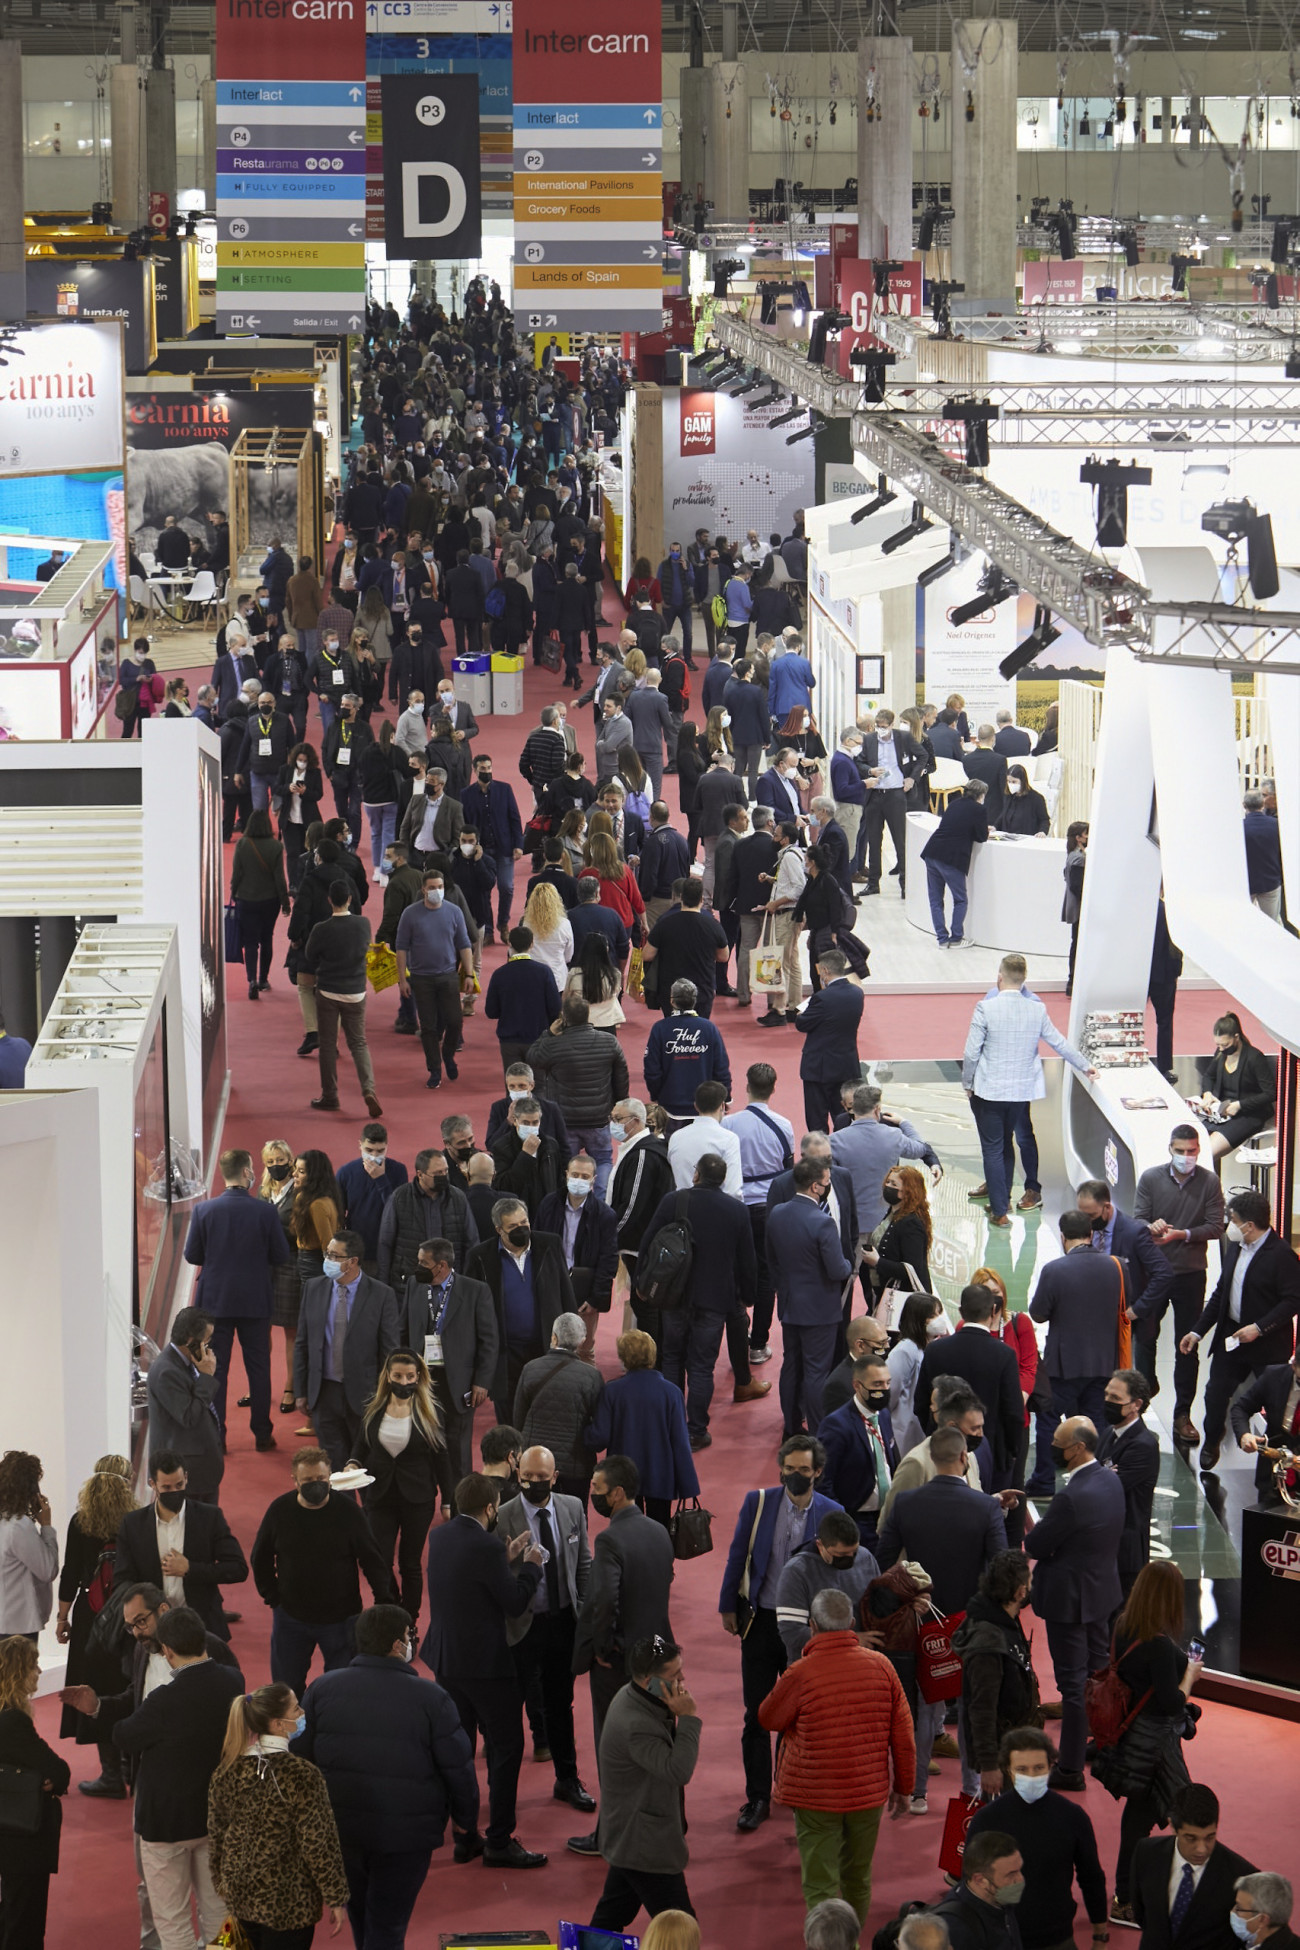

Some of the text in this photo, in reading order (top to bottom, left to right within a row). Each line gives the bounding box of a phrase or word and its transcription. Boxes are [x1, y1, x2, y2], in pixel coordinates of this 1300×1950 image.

[229, 0, 354, 20] Intercarn
[383, 3, 412, 16] CC3
[524, 28, 649, 54] Intercarn
[416, 38, 430, 59] 3
[230, 88, 283, 101] Interlact
[421, 104, 440, 117] P3
[527, 112, 580, 124] Interlact
[234, 132, 247, 142] P4
[233, 157, 299, 169] Restaurama
[527, 156, 541, 165] P2
[282, 183, 336, 192] EQUIPPED
[527, 180, 634, 190] International Pavilions
[401, 161, 467, 238] D
[528, 204, 601, 216] Grocery Foods
[232, 224, 246, 233] P6
[528, 248, 541, 257] P1
[532, 271, 620, 284] Lands of Spain
[896, 280, 912, 288] 1929
[293, 318, 318, 327] Salida
[324, 318, 338, 327] Exit
[0, 360, 96, 401] arnia
[56, 403, 95, 422] anys
[684, 417, 712, 433] GAM
[193, 426, 229, 440] anys
[683, 433, 713, 446] family
[672, 1028, 701, 1045] Huf
[665, 1041, 709, 1054] Forever
[925, 1637, 946, 1651] FRIT
